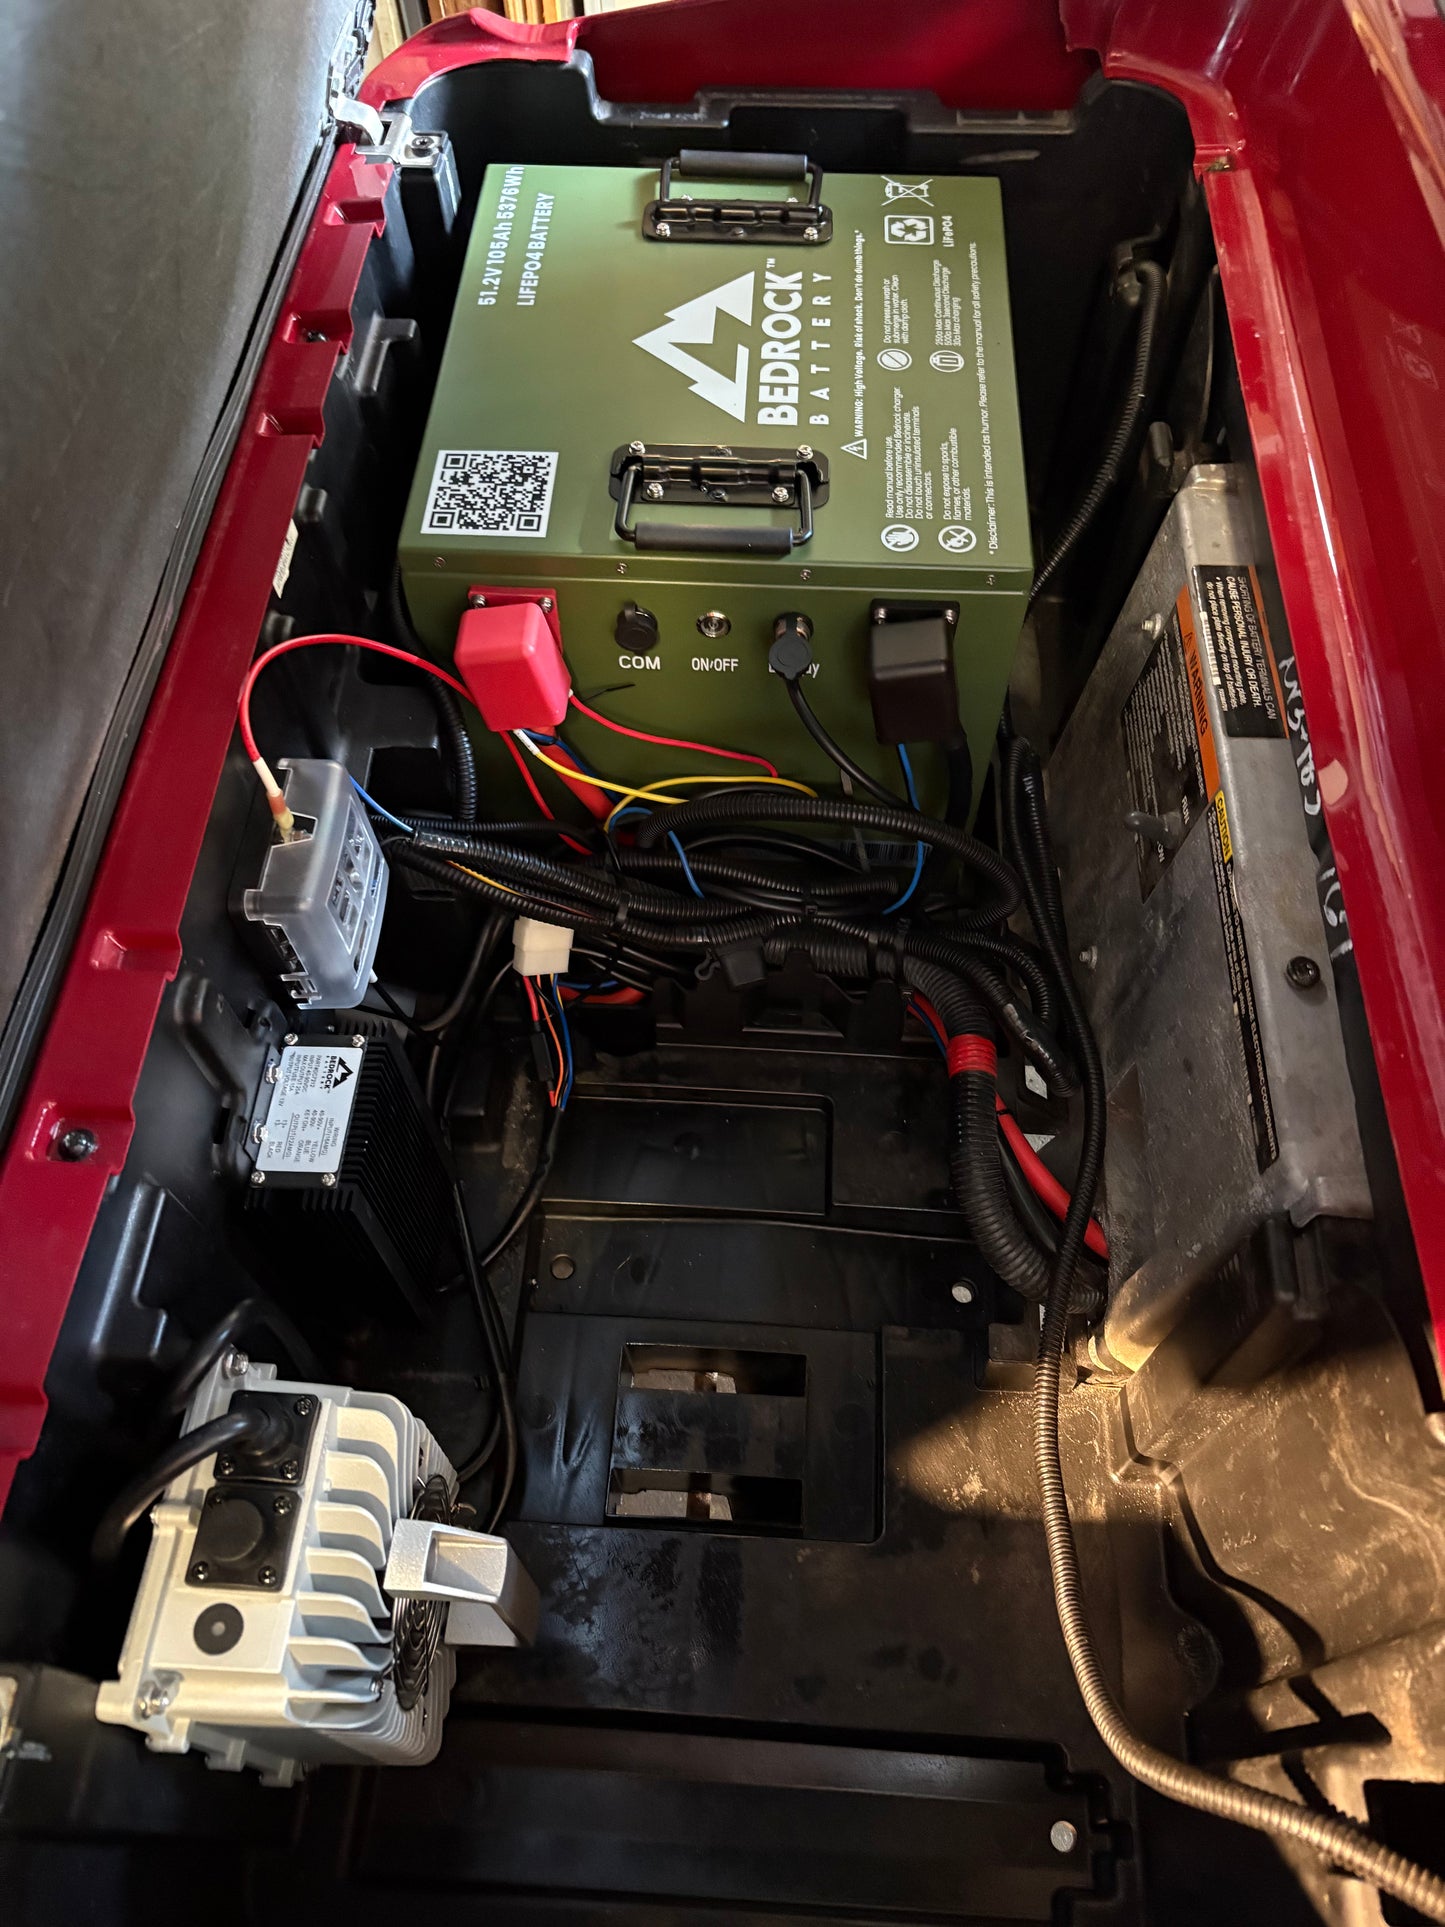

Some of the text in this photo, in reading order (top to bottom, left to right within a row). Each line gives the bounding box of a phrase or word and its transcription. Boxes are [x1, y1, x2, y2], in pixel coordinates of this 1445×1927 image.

[477, 166, 525, 306] 51.2V 105Ah 5376Wh
[516, 192, 555, 306] LIFEPO4 BATTERY
[854, 255, 863, 274] dumb
[932, 259, 943, 286] Discharge
[969, 242, 979, 280] precautions.
[854, 283, 864, 300] Don't
[941, 267, 951, 293] Discharge
[971, 280, 980, 300] safety
[882, 285, 891, 300] wash
[934, 287, 942, 318] Continuous
[854, 303, 864, 325] shock.
[883, 301, 893, 324] pressure
[952, 297, 961, 322] charging
[972, 301, 980, 309] all
[973, 310, 981, 318] for
[883, 325, 891, 334] not
[893, 314, 901, 343] submerge
[901, 298, 910, 344] with damp cloth.
[973, 319, 982, 345] manual
[757, 271, 803, 426] BEDROCK
[808, 272, 832, 426] BATTERY
[854, 333, 864, 348] Risk
[883, 335, 891, 343] Do
[976, 346, 984, 357] the
[854, 350, 866, 379] Voltage.
[977, 367, 986, 383] refer
[854, 380, 866, 397] High
[979, 384, 987, 407] Please
[854, 398, 864, 438] WARNING:
[903, 411, 911, 444] incinerate.
[980, 408, 989, 434] humor.
[949, 428, 958, 468] combustible
[984, 434, 990, 444] as
[884, 450, 892, 471] before
[893, 387, 904, 518] Use only recommended Bedrock charger.
[912, 406, 923, 519] Do not touch uninsulated terminals
[982, 445, 992, 479] intended
[885, 472, 893, 498] manual
[904, 453, 912, 495] disassemble
[942, 473, 951, 496] expose
[951, 469, 959, 486] other
[905, 496, 913, 508] not
[924, 471, 933, 519] or connectors.
[986, 487, 994, 503] This
[885, 499, 894, 518] Read
[905, 509, 913, 519] Do
[943, 509, 951, 520] Do
[1216, 582, 1225, 598] When
[1208, 600, 1219, 616] place
[1218, 599, 1229, 625] removing
[1212, 616, 1222, 631] plate
[1215, 632, 1227, 653] directly
[1224, 626, 1237, 658] component
[1226, 576, 1261, 707] CAUSE PERSONAL INJURY OR DEATH.
[1238, 576, 1277, 720] SHORTING OF BATTERY TERMINALS CAN
[619, 656, 660, 670] COM
[692, 657, 739, 672] ON/OFF
[1222, 654, 1228, 662] on
[1222, 663, 1231, 673] top
[1232, 660, 1243, 687] mounting
[1189, 650, 1208, 737] WARNING
[1226, 681, 1238, 709] batteries.
[1217, 797, 1231, 857] CAUTION
[1234, 913, 1240, 925] TO
[1244, 980, 1255, 1022] DAMAGE
[1251, 1022, 1265, 1086] ELECTRONIC
[1261, 1086, 1277, 1160] COMPONENTS
[296, 1066, 306, 1084] OUTPUT
[324, 1056, 337, 1089] BEDROCK
[293, 1140, 304, 1163] ORANGE
[308, 1140, 318, 1163] YELLOW
